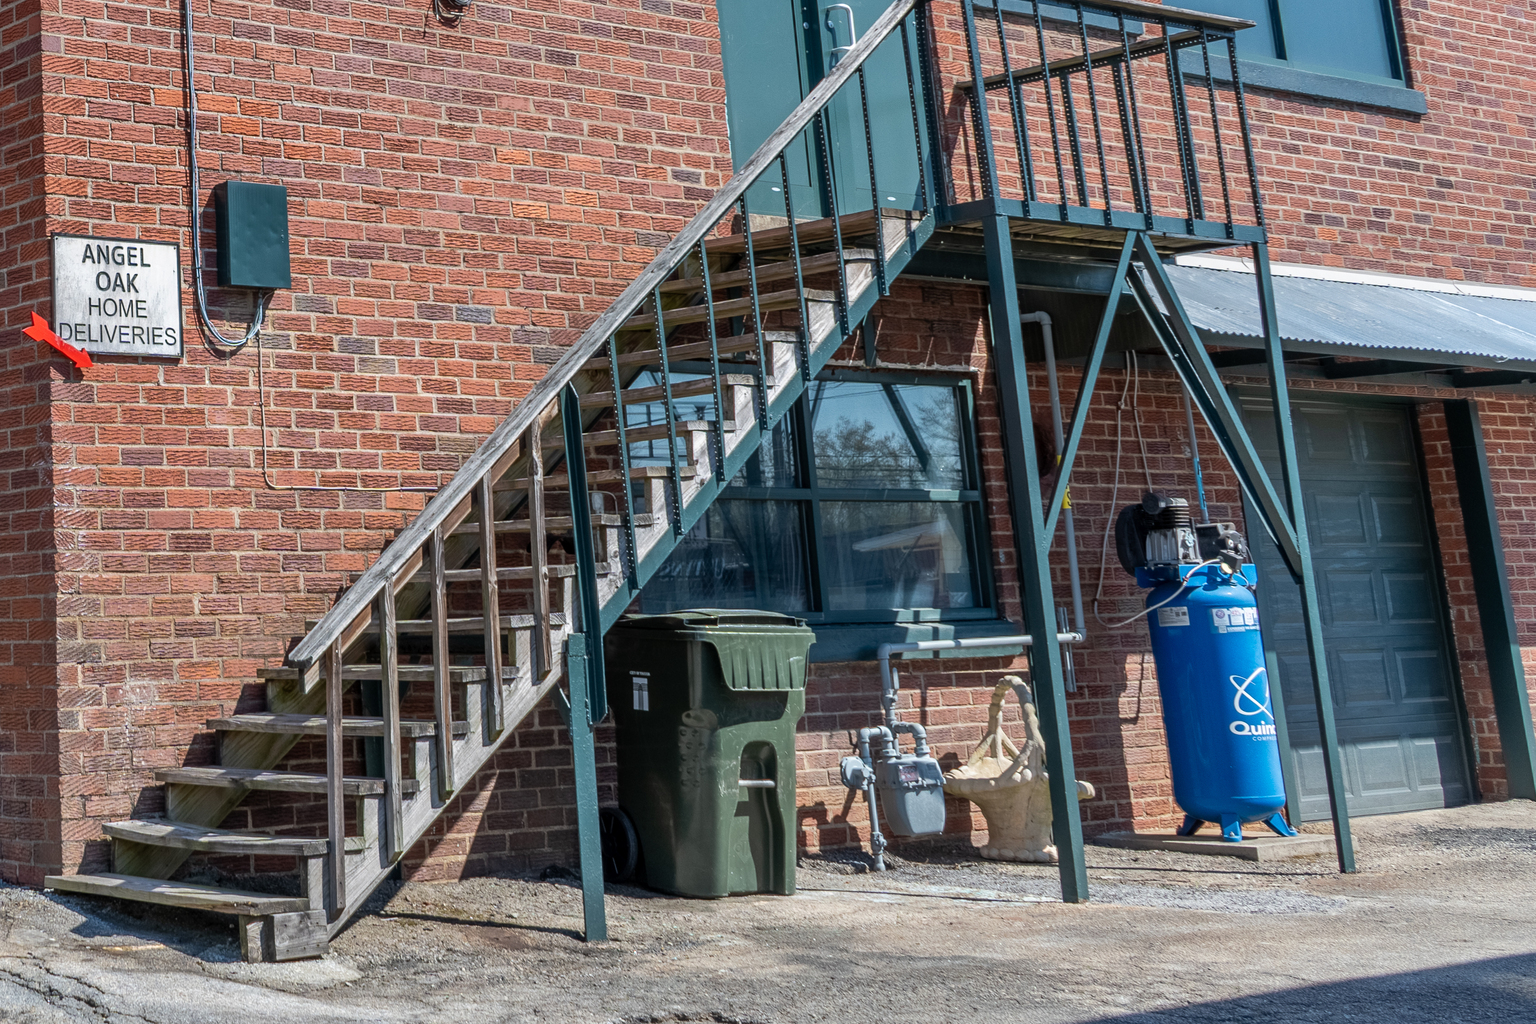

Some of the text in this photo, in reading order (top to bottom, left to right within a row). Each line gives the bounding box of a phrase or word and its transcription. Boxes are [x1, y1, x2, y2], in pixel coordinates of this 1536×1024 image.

[82, 243, 151, 268] ANGEL
[96, 271, 139, 293] OAK
[88, 297, 148, 318] HOME
[59, 322, 177, 346] DELIVERIES
